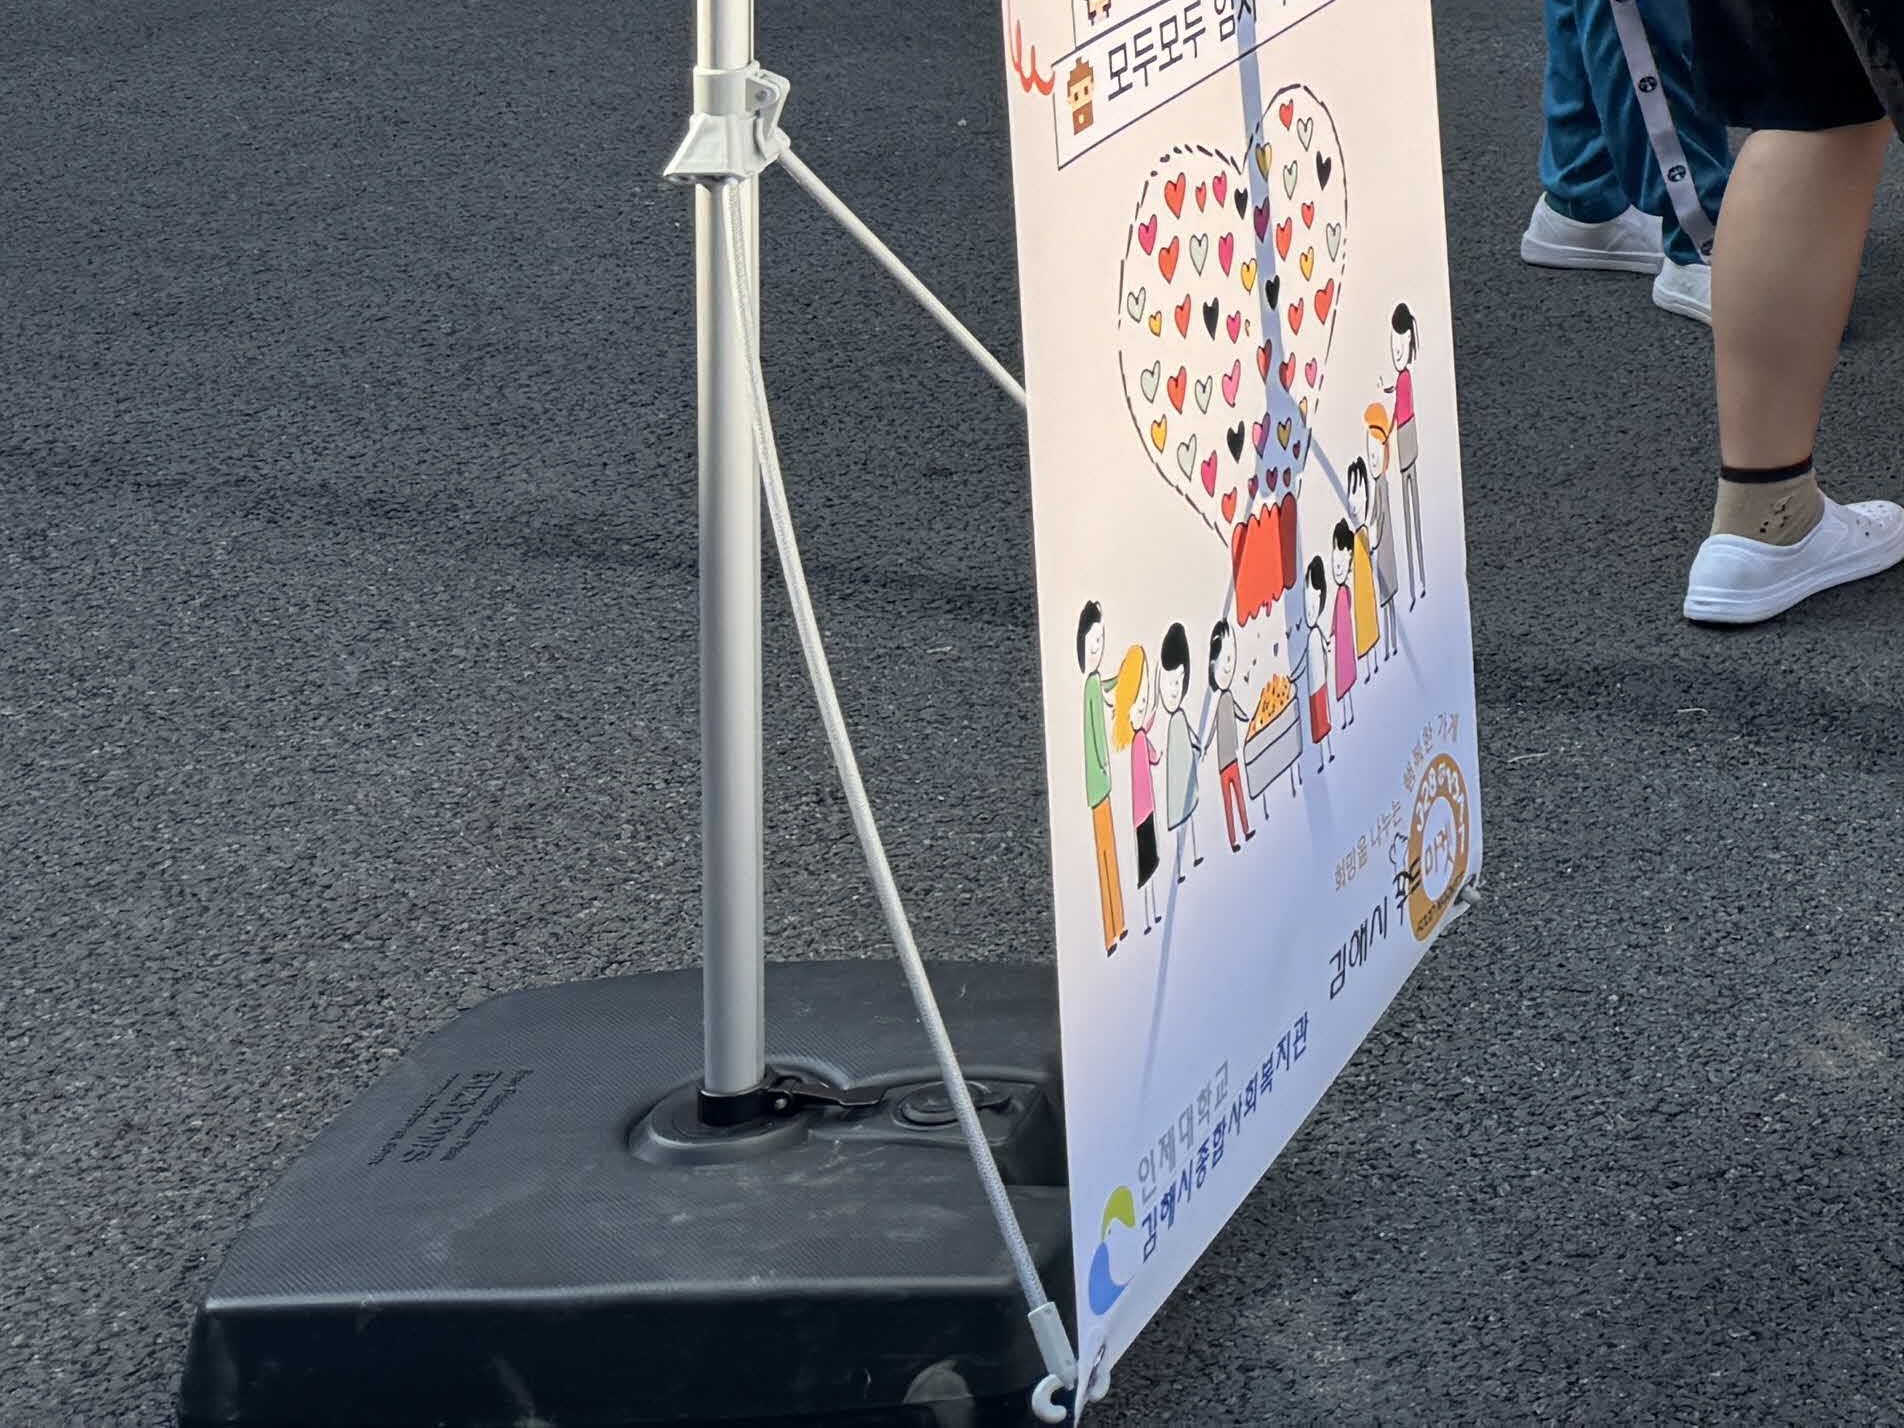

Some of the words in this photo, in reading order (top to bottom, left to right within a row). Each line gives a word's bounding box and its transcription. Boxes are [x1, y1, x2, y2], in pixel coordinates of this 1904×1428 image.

[1107, 0, 1206, 102] 모두모두
[1137, 1059, 1229, 1206] 인제대학교
[1140, 1010, 1309, 1265] 김해시종합사회복지관
